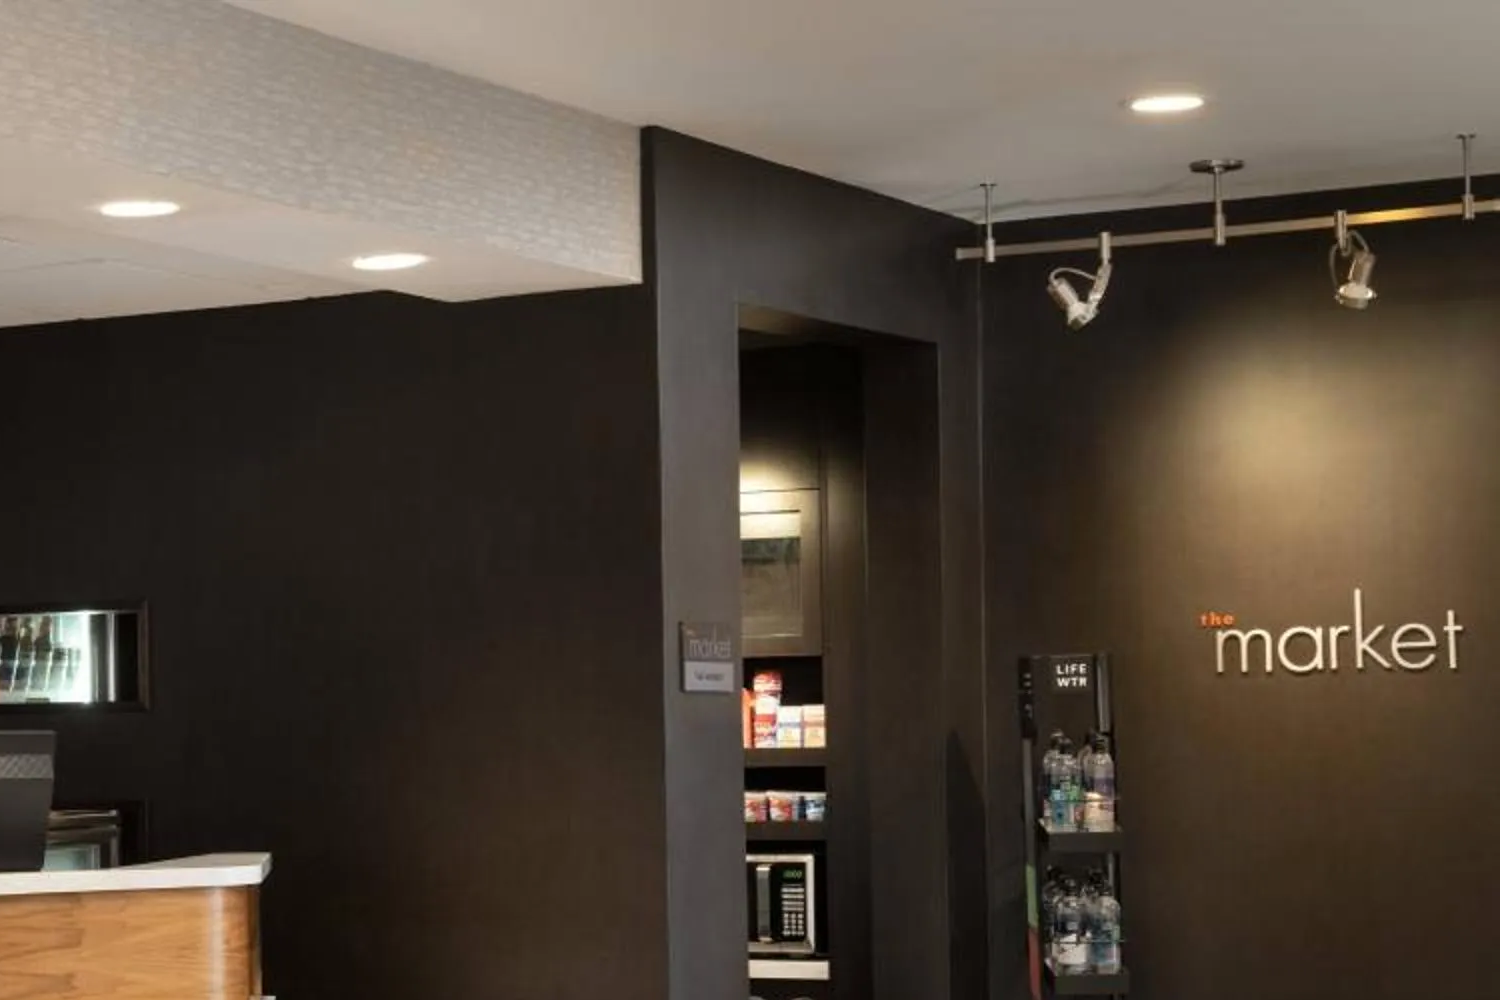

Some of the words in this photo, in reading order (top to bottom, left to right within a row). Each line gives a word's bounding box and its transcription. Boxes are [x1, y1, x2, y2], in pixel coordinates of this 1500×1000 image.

[1199, 611, 1235, 626] the
[1215, 587, 1464, 673] market
[1055, 663, 1088, 675] LIFE
[1055, 676, 1088, 688] WTR
